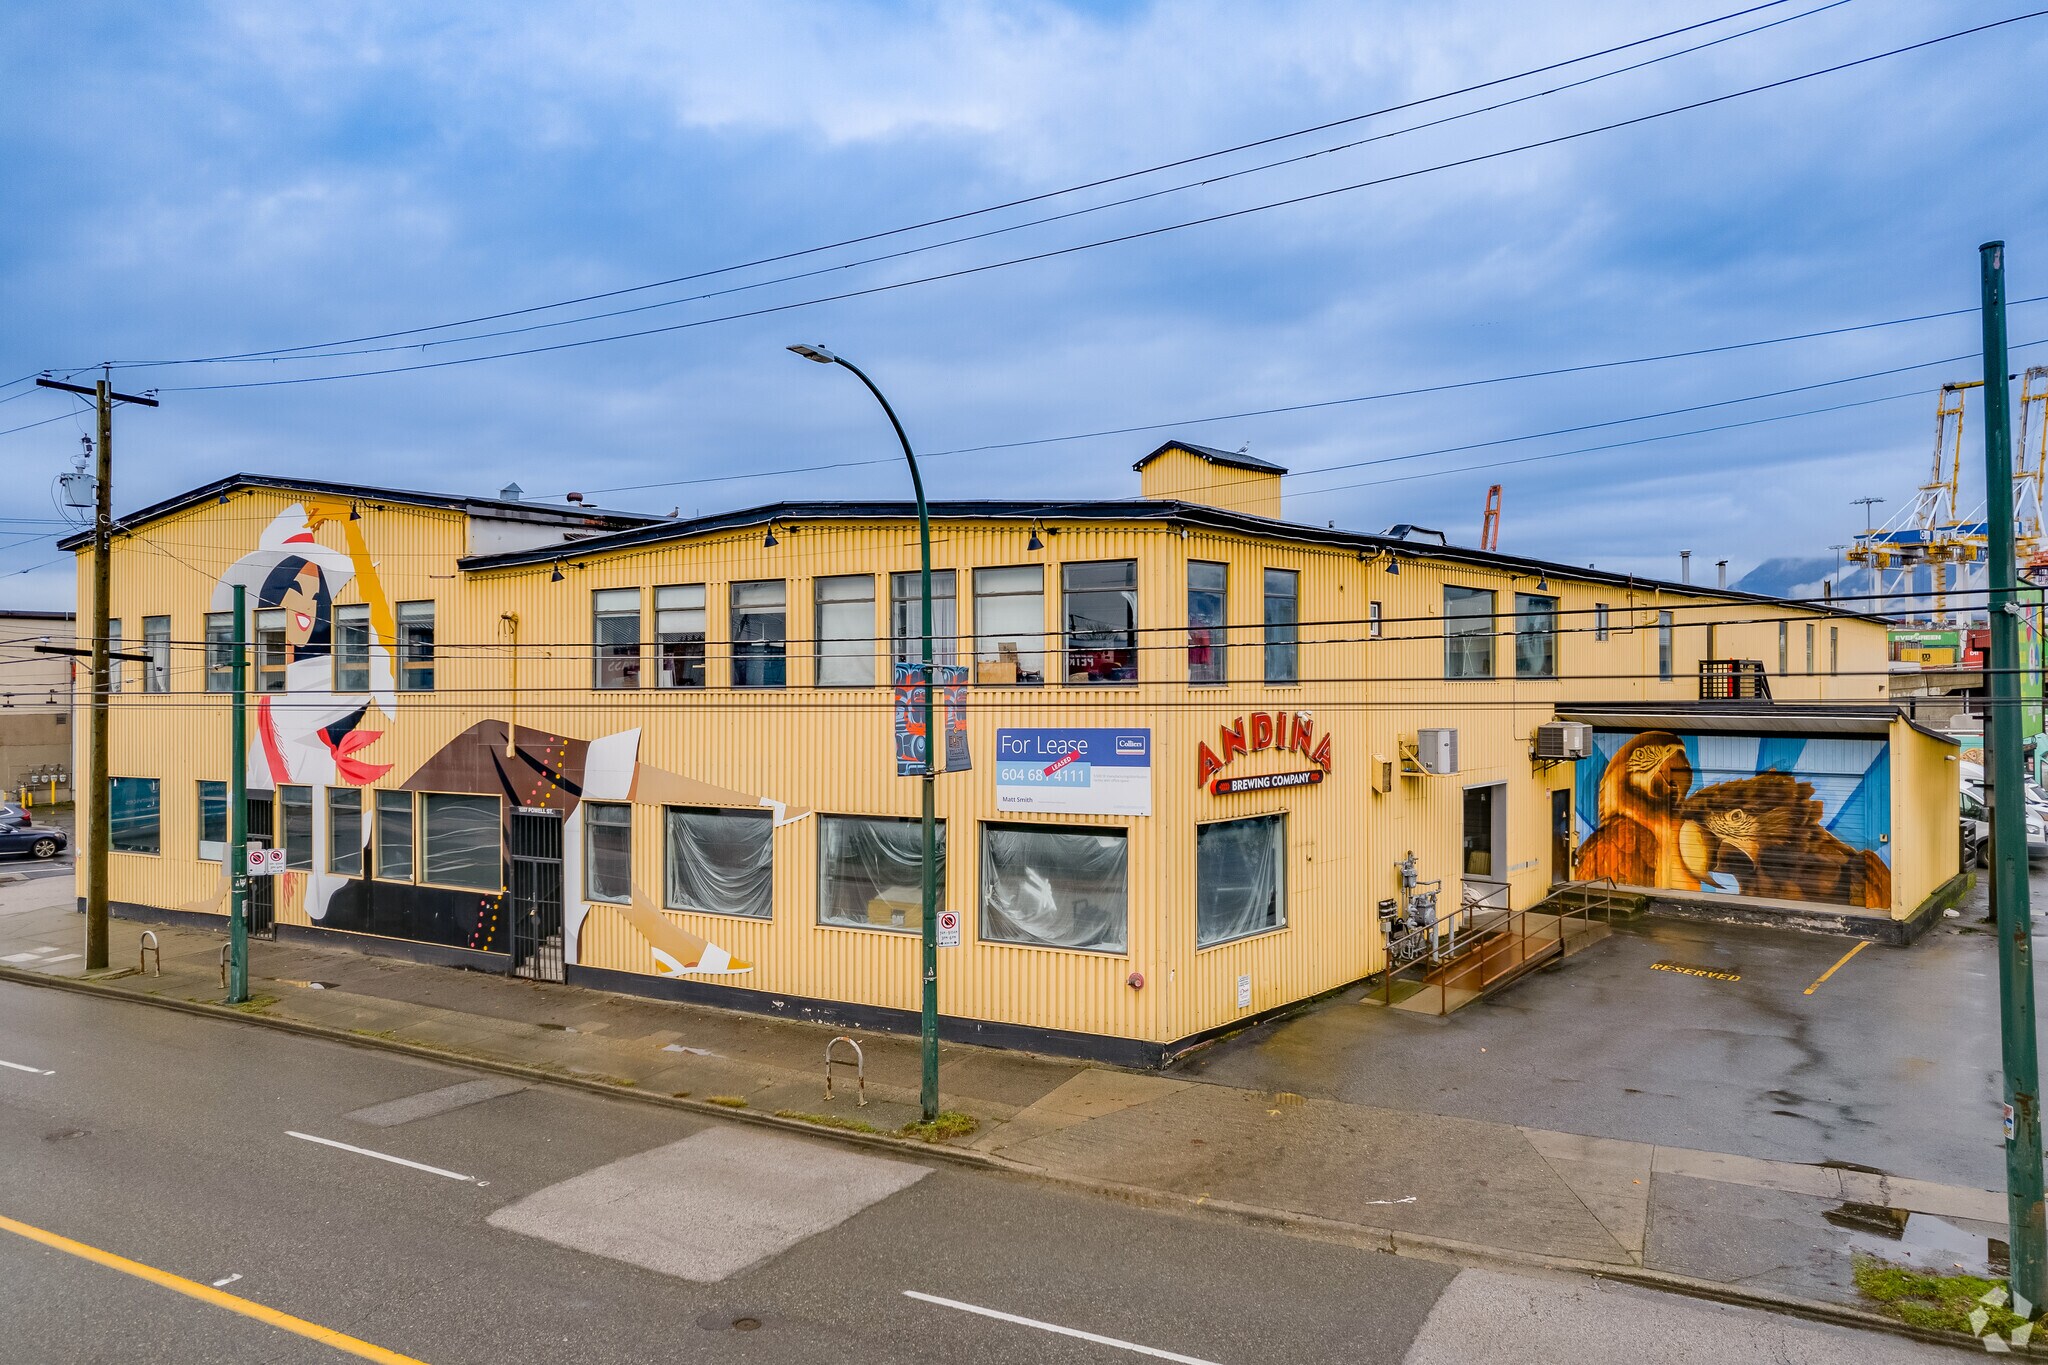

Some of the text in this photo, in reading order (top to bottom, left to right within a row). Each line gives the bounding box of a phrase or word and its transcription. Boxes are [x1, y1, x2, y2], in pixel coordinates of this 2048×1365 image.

[1001, 735, 1088, 755] For Lease
[1119, 740, 1143, 748] Colliers
[1051, 756, 1072, 771] LEASED
[1001, 768, 1024, 781] 604
[1054, 769, 1084, 782] 4111
[1231, 772, 1310, 791] BREWING COMPANY
[1650, 963, 1741, 981] RESERVED
